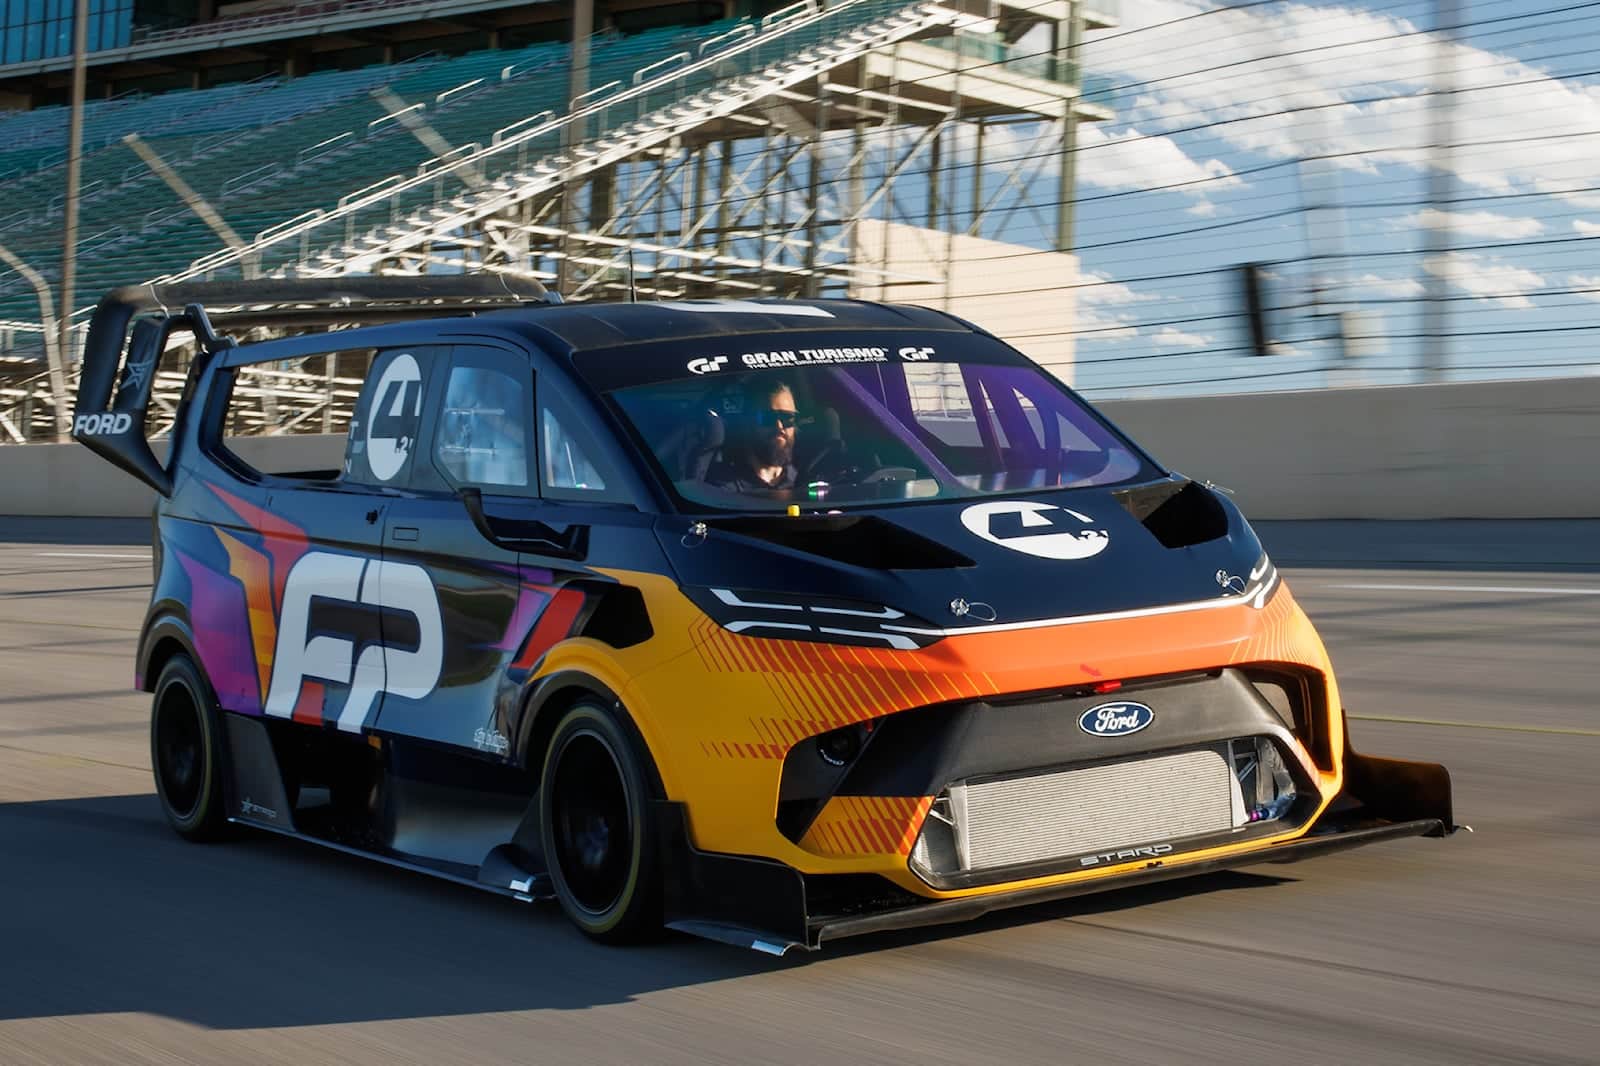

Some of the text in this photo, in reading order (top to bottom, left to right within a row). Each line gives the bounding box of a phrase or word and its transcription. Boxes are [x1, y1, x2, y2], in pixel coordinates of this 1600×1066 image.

[741, 347, 885, 364] GRAN TURISMO
[74, 413, 132, 436] FORD
[1093, 705, 1141, 733] Ford
[1080, 843, 1173, 867] STARD
